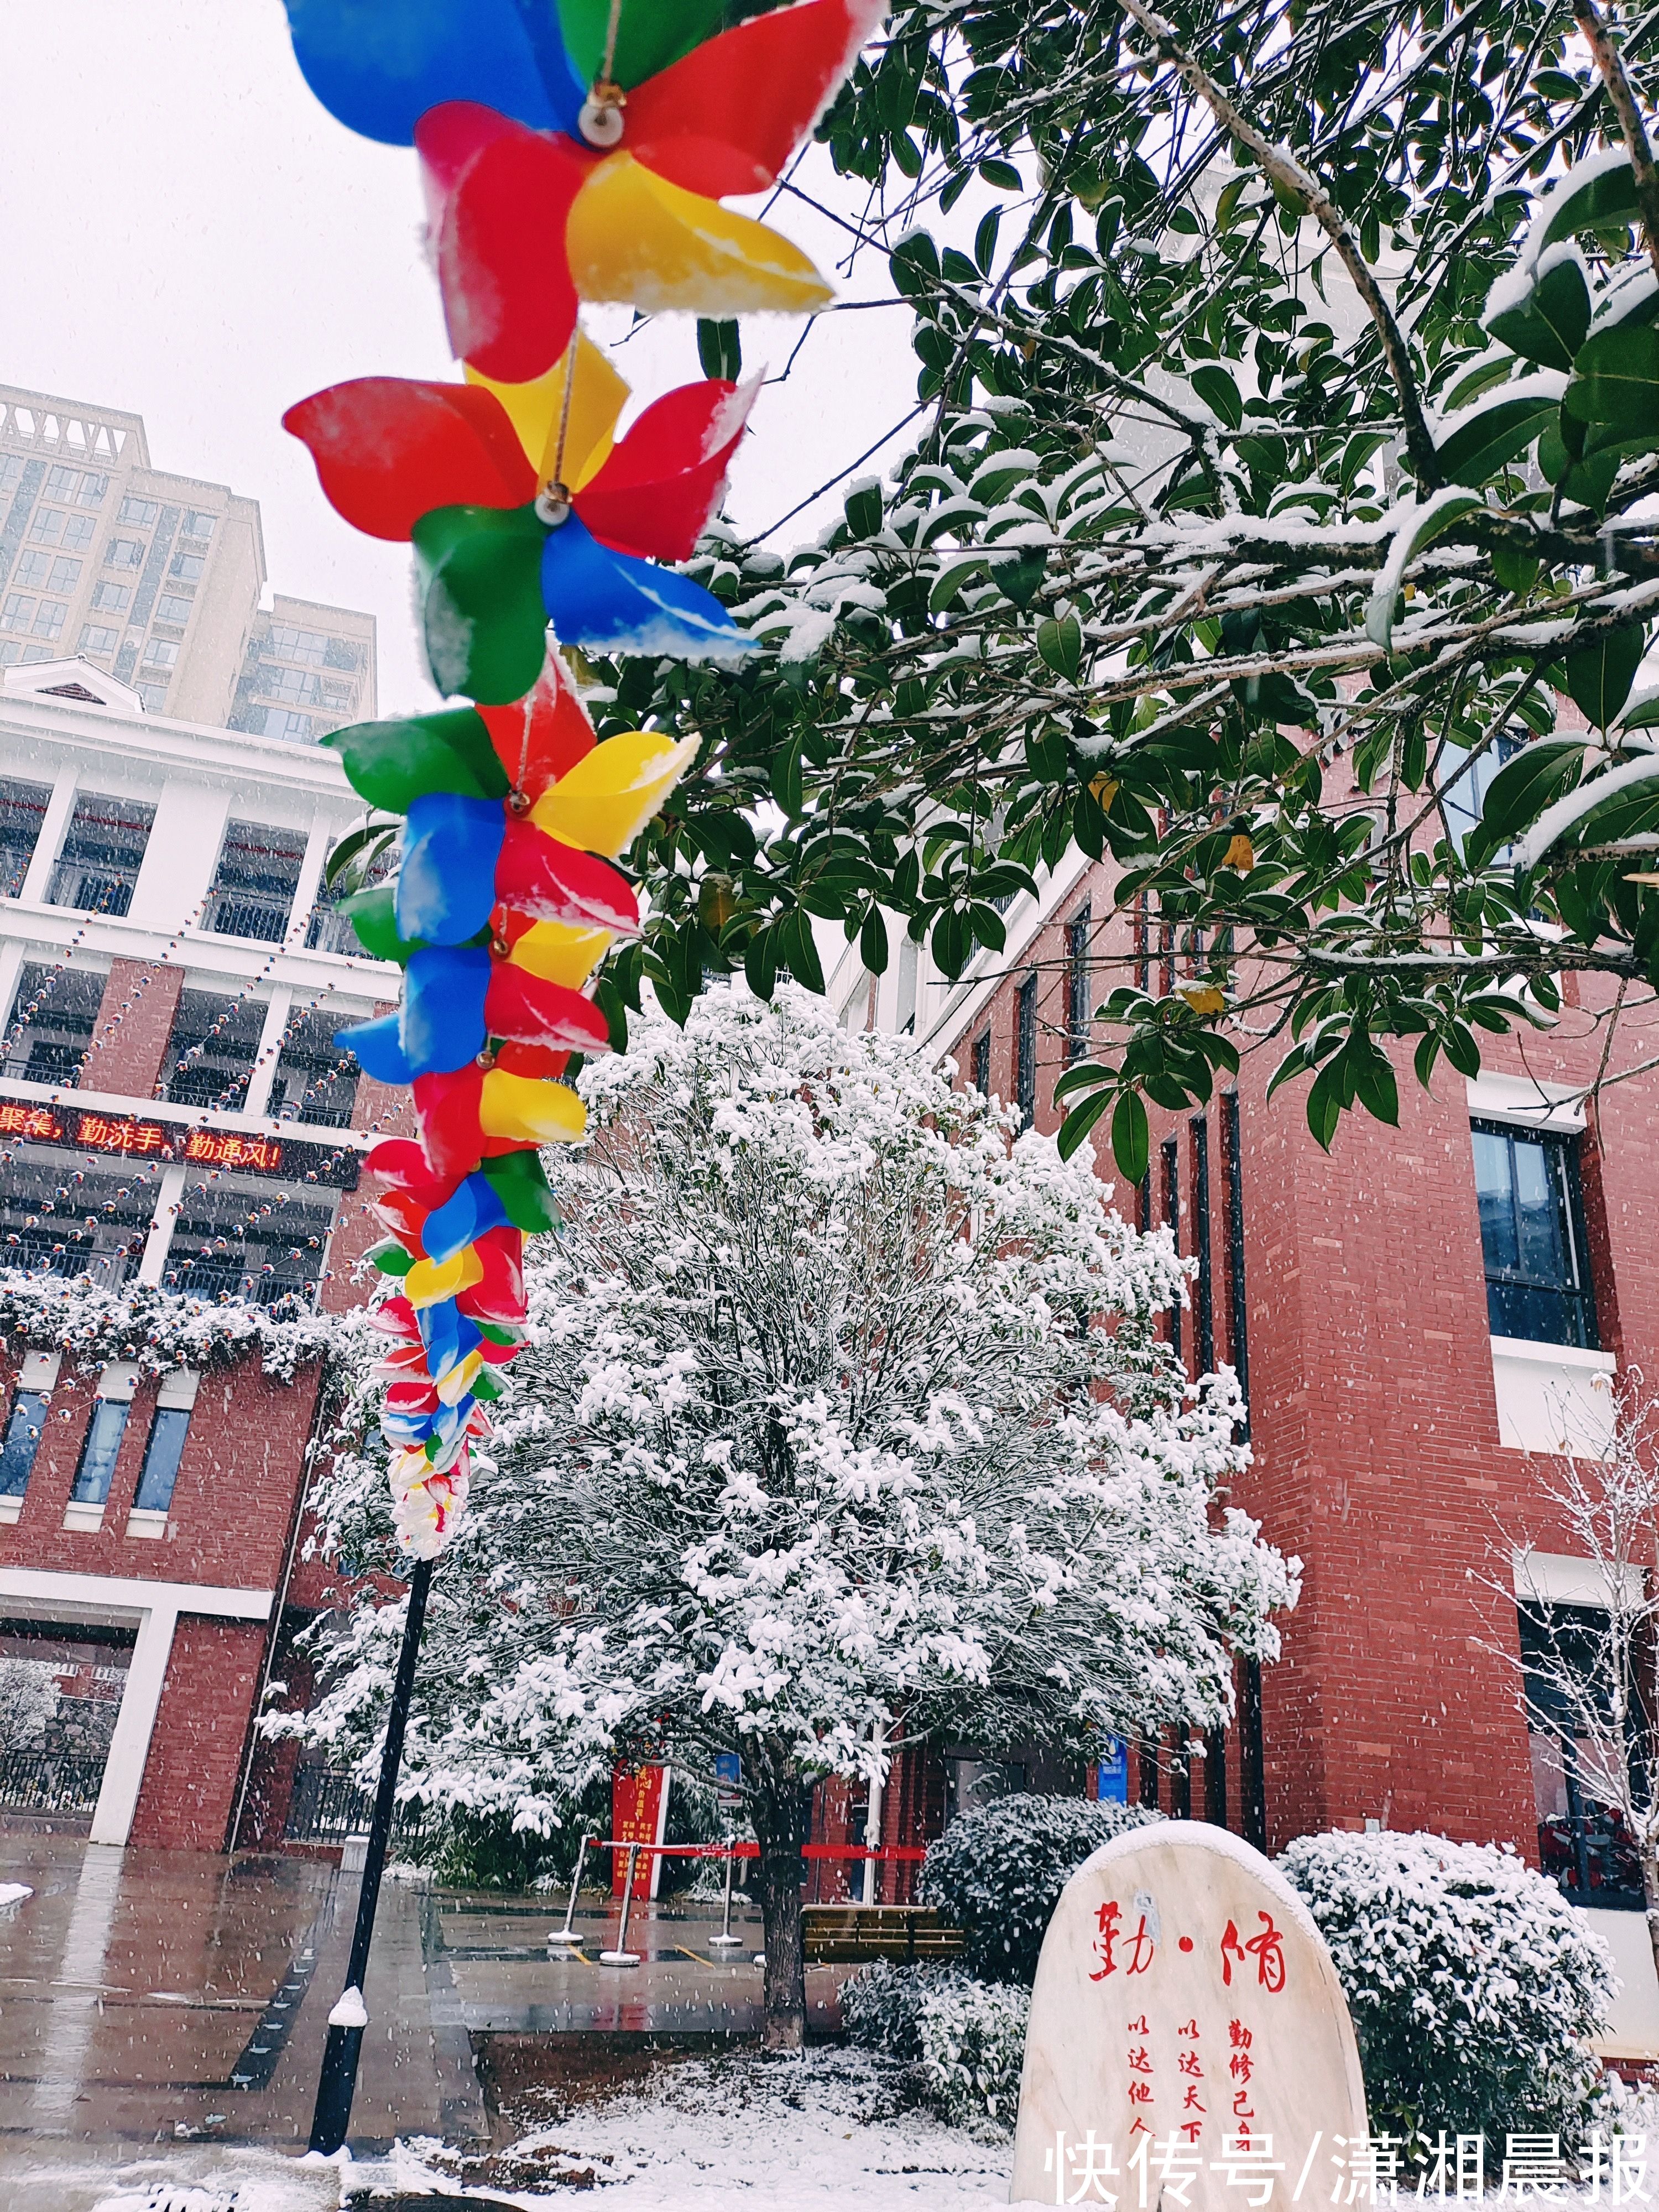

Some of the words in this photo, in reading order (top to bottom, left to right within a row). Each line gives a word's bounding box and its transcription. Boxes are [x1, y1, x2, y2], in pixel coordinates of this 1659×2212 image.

[1128, 2015, 1156, 2136] 以达他人
[1178, 2019, 1207, 2143] 以达天下
[1229, 2018, 1254, 2151] 勤修己身
